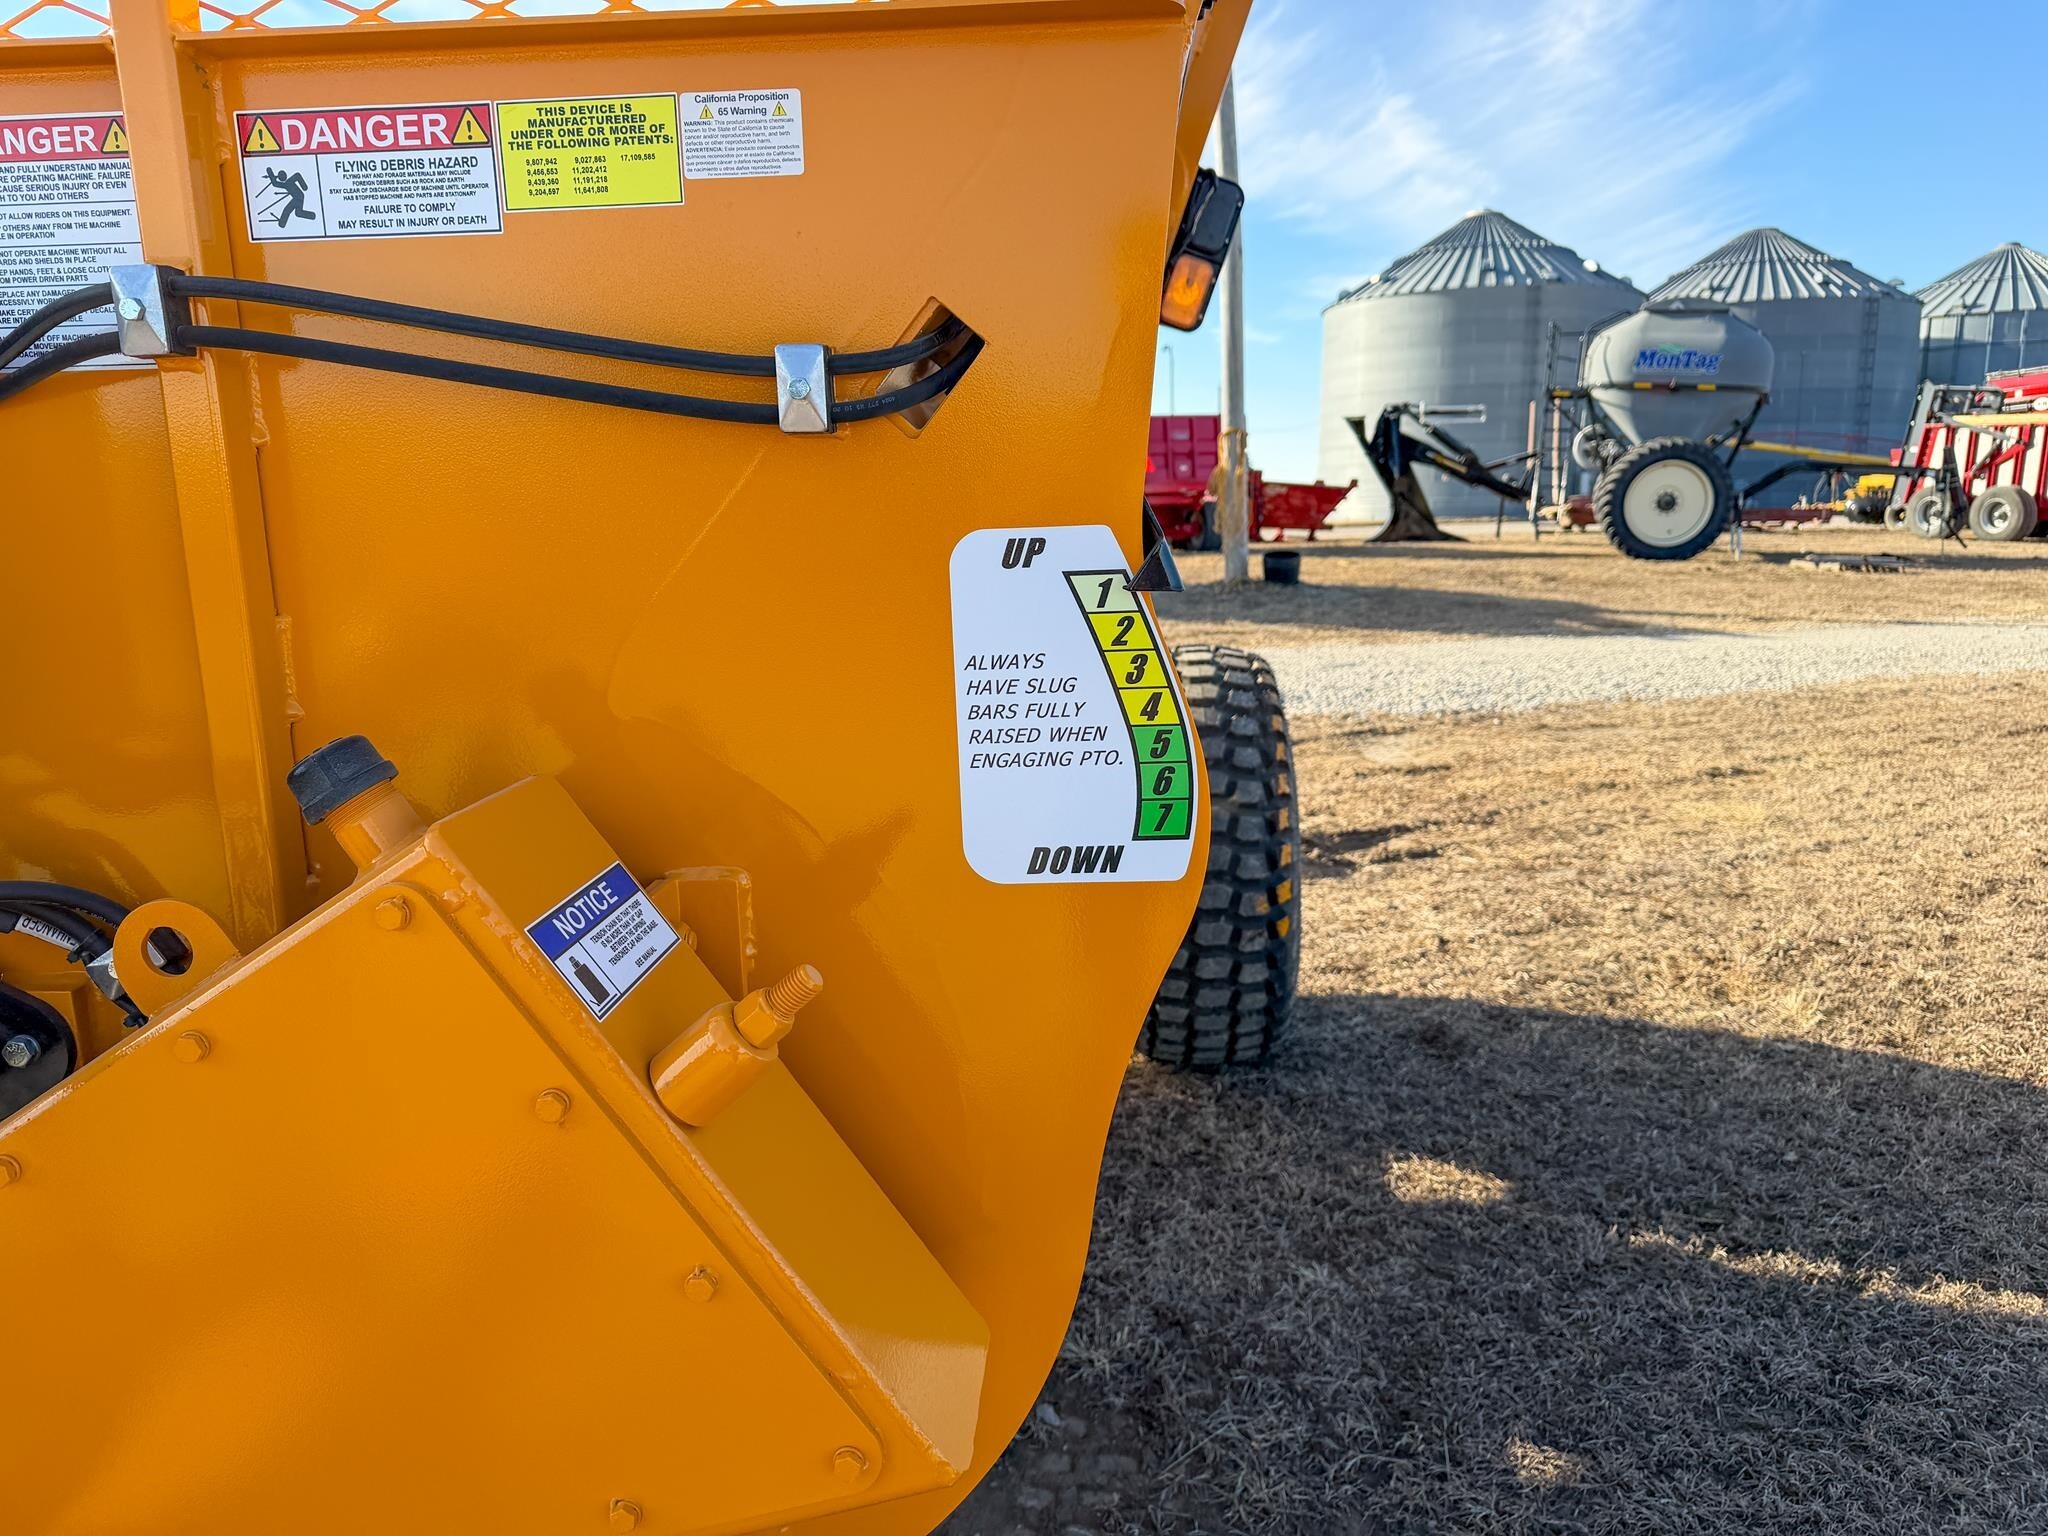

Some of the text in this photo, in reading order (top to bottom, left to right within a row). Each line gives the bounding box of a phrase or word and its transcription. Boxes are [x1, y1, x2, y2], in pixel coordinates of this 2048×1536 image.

[695, 92, 789, 103] California Proposition
[537, 104, 632, 117] THIS DEVICE IS
[718, 106, 767, 116] 65 Warning
[528, 114, 646, 128] MANUFACTURERED
[0, 126, 98, 155] NGER
[281, 114, 450, 150] DANGER
[511, 124, 665, 140] UNDER ONE OR MORE OF
[508, 134, 673, 151] THE FOLLOWING PATENTS:
[17, 165, 41, 173] FULLY
[43, 163, 97, 172] UNDERSTAND
[98, 162, 132, 170] MANUAL
[335, 156, 478, 172] FLYING DEBRIS HAZARD
[526, 158, 557, 166] 9,807,942
[572, 166, 607, 174] 11,202,412
[10, 174, 56, 183] OPERATING
[57, 173, 96, 181] MACHINE.
[98, 172, 131, 180] FAILURE
[26, 183, 60, 192] SERIOUS
[62, 182, 90, 190] INJURY
[105, 181, 127, 189] EVEN
[574, 176, 607, 184] 11,191,218
[20, 194, 36, 202] YOU
[38, 193, 55, 201] AND
[57, 192, 89, 200] OTHERS
[91, 209, 132, 217] EQUIPMENT.
[364, 202, 455, 214] FAILURE TO COMPLY
[2, 224, 30, 232] OTHERS
[89, 221, 121, 229] MACHINE
[338, 216, 487, 229] MAY RESULT IN INJURY OR DEATH
[16, 231, 55, 240] OPERATION
[9, 268, 35, 276] HANDS,
[1635, 350, 1722, 374] MonTag
[1002, 537, 1046, 569] UP
[1097, 578, 1113, 608] 1
[1111, 616, 1134, 646] 2
[964, 653, 1046, 671] ALWAYS
[1126, 654, 1148, 684] 3
[966, 677, 1078, 696] HAVE SLUG
[967, 702, 1086, 720] BARS FULLY
[1140, 692, 1163, 721] 4
[968, 726, 1107, 745] RAISED WHEN
[1150, 729, 1173, 758] 5
[970, 750, 1124, 769] ENGAGING PTO.
[1153, 766, 1174, 796] 6
[1154, 803, 1173, 832] 7
[1027, 845, 1124, 874] DOWN
[552, 881, 618, 940] NOTICE
[590, 928, 608, 944] TENSION
[605, 919, 618, 931] CHAIN
[620, 908, 631, 918] THAT
[628, 899, 641, 911] THERE
[604, 936, 612, 944] NO
[610, 927, 623, 939] MORE
[620, 920, 631, 931] THAN
[634, 909, 643, 918] GAP
[22, 915, 76, 947] NHANCER
[610, 918, 646, 952] BETWEEN THE SPRING
[609, 946, 630, 966] TENSIONER
[627, 940, 636, 949] CAP
[635, 934, 643, 944] AND
[640, 928, 649, 937] THE
[635, 946, 657, 967] SEE MANUAL
